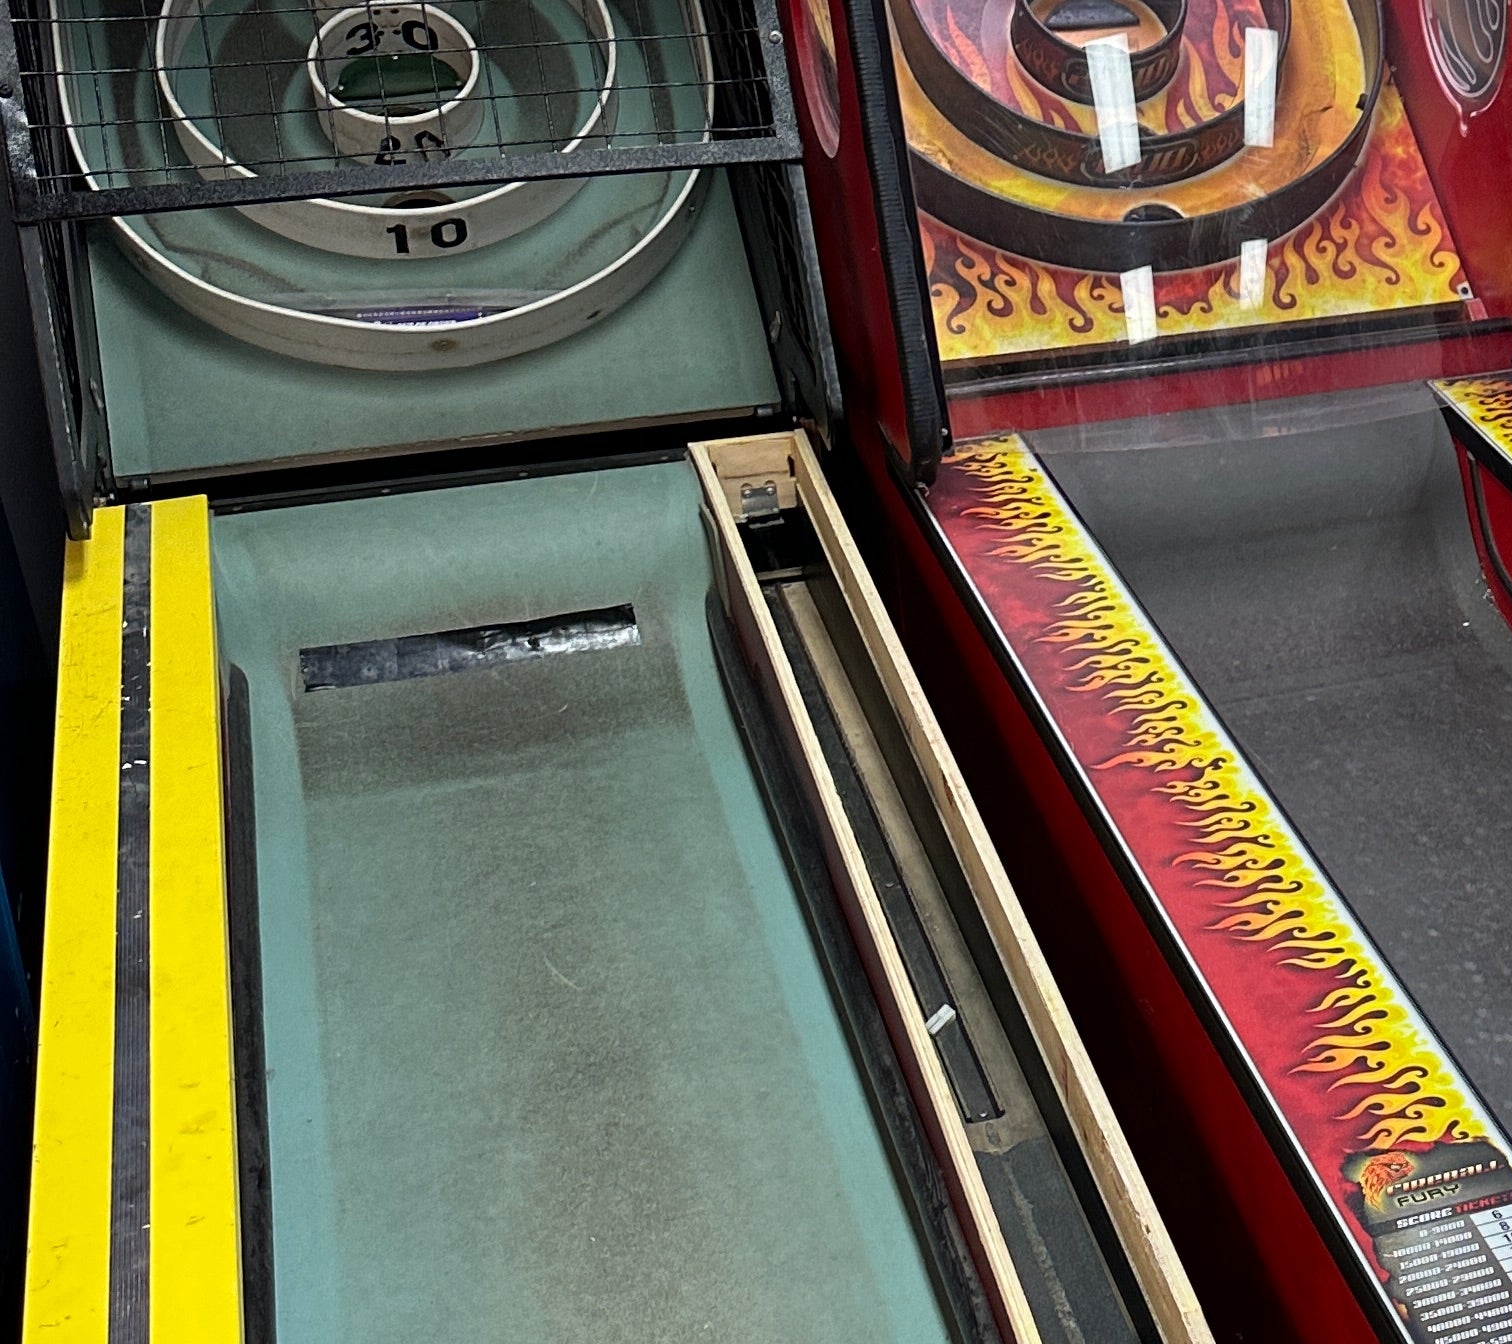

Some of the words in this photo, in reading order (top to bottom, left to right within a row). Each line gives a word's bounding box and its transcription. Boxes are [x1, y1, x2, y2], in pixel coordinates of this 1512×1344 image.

[345, 20, 439, 56] 30
[386, 218, 468, 253] 10
[1396, 1182, 1460, 1208] FURY
[1396, 1206, 1453, 1229] SCORE
[1492, 1210, 1503, 1219] 6
[1499, 1221, 1510, 1231] 8
